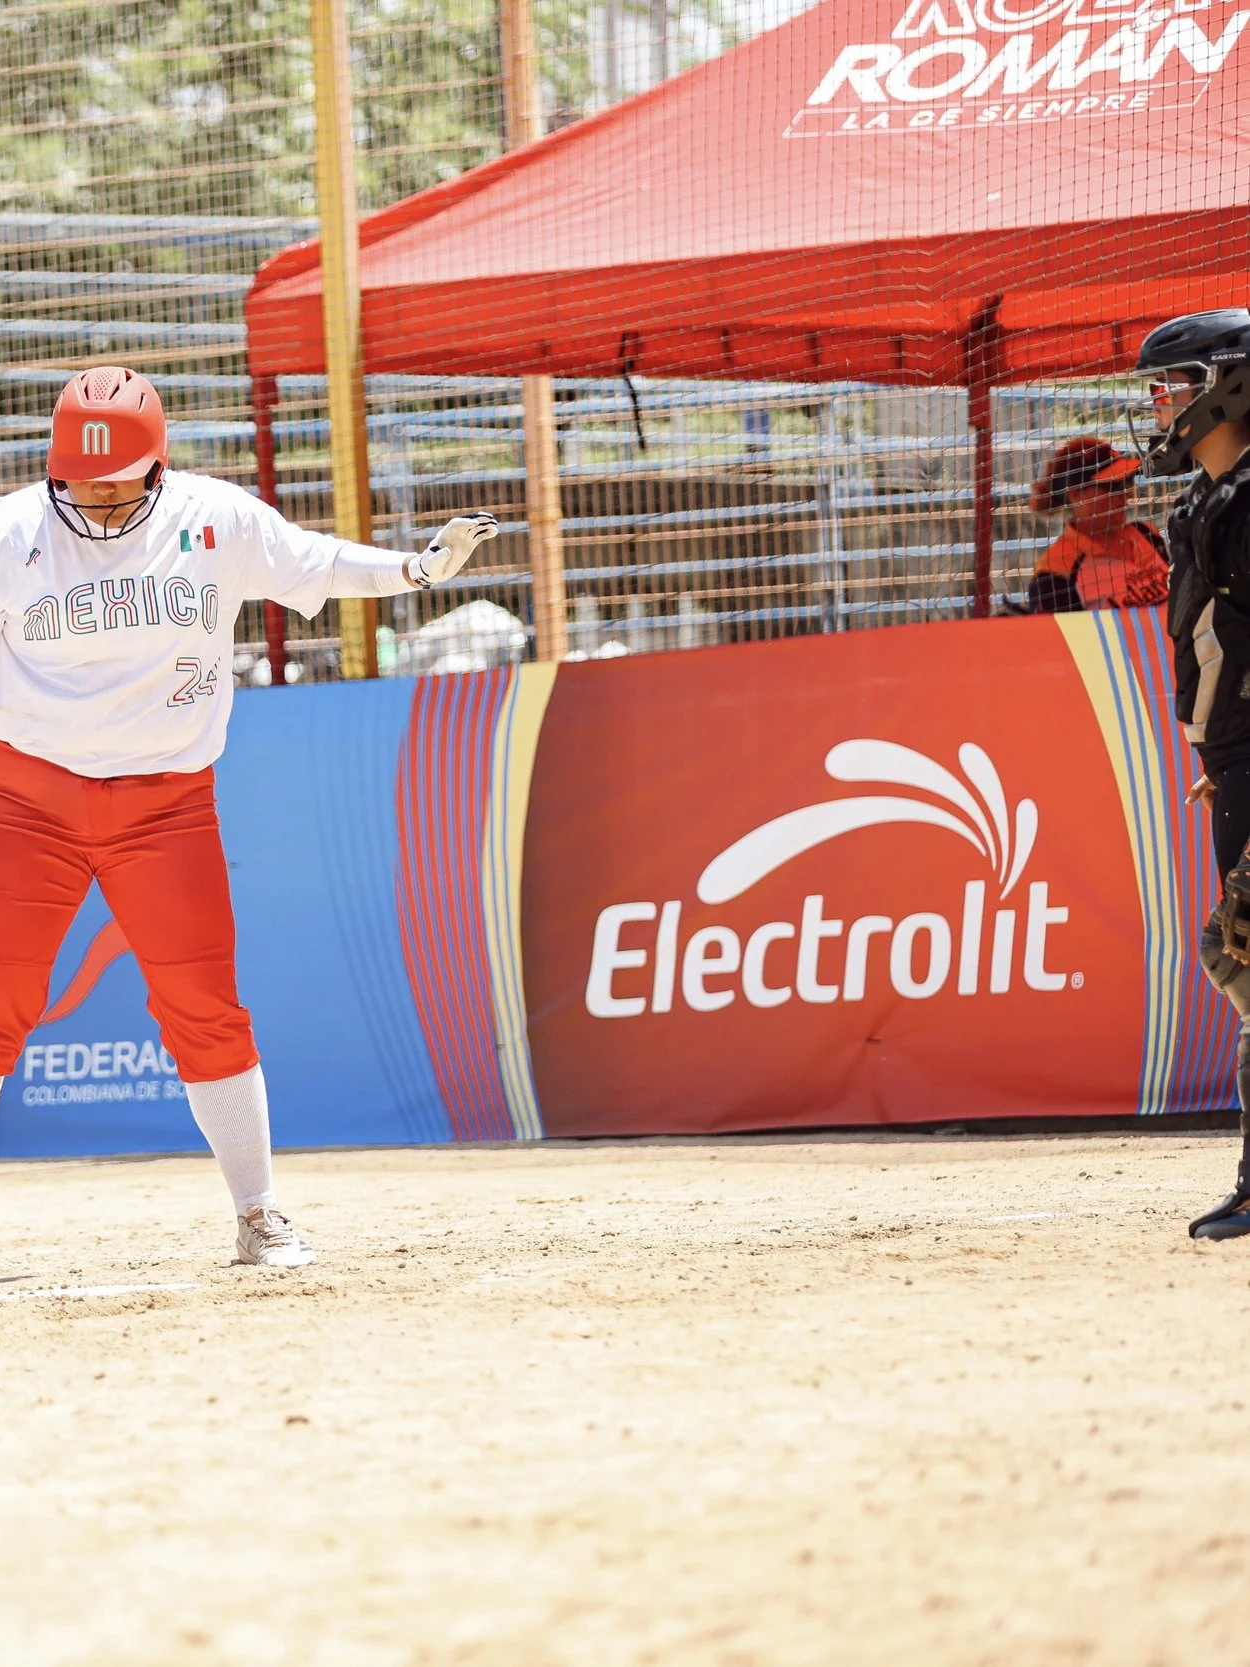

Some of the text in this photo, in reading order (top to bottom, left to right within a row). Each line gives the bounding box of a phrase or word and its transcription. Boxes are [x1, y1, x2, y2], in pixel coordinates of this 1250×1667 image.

[841, 91, 1154, 130] LA DE SIEMPRE
[1211, 352, 1246, 361] EASTON
[23, 575, 218, 641] MEXICO
[585, 880, 1069, 1019] Electrolit
[23, 1039, 179, 1082] FEDERAC
[22, 1083, 135, 1107] COLOMBIANA
[136, 1080, 161, 1102] DE
